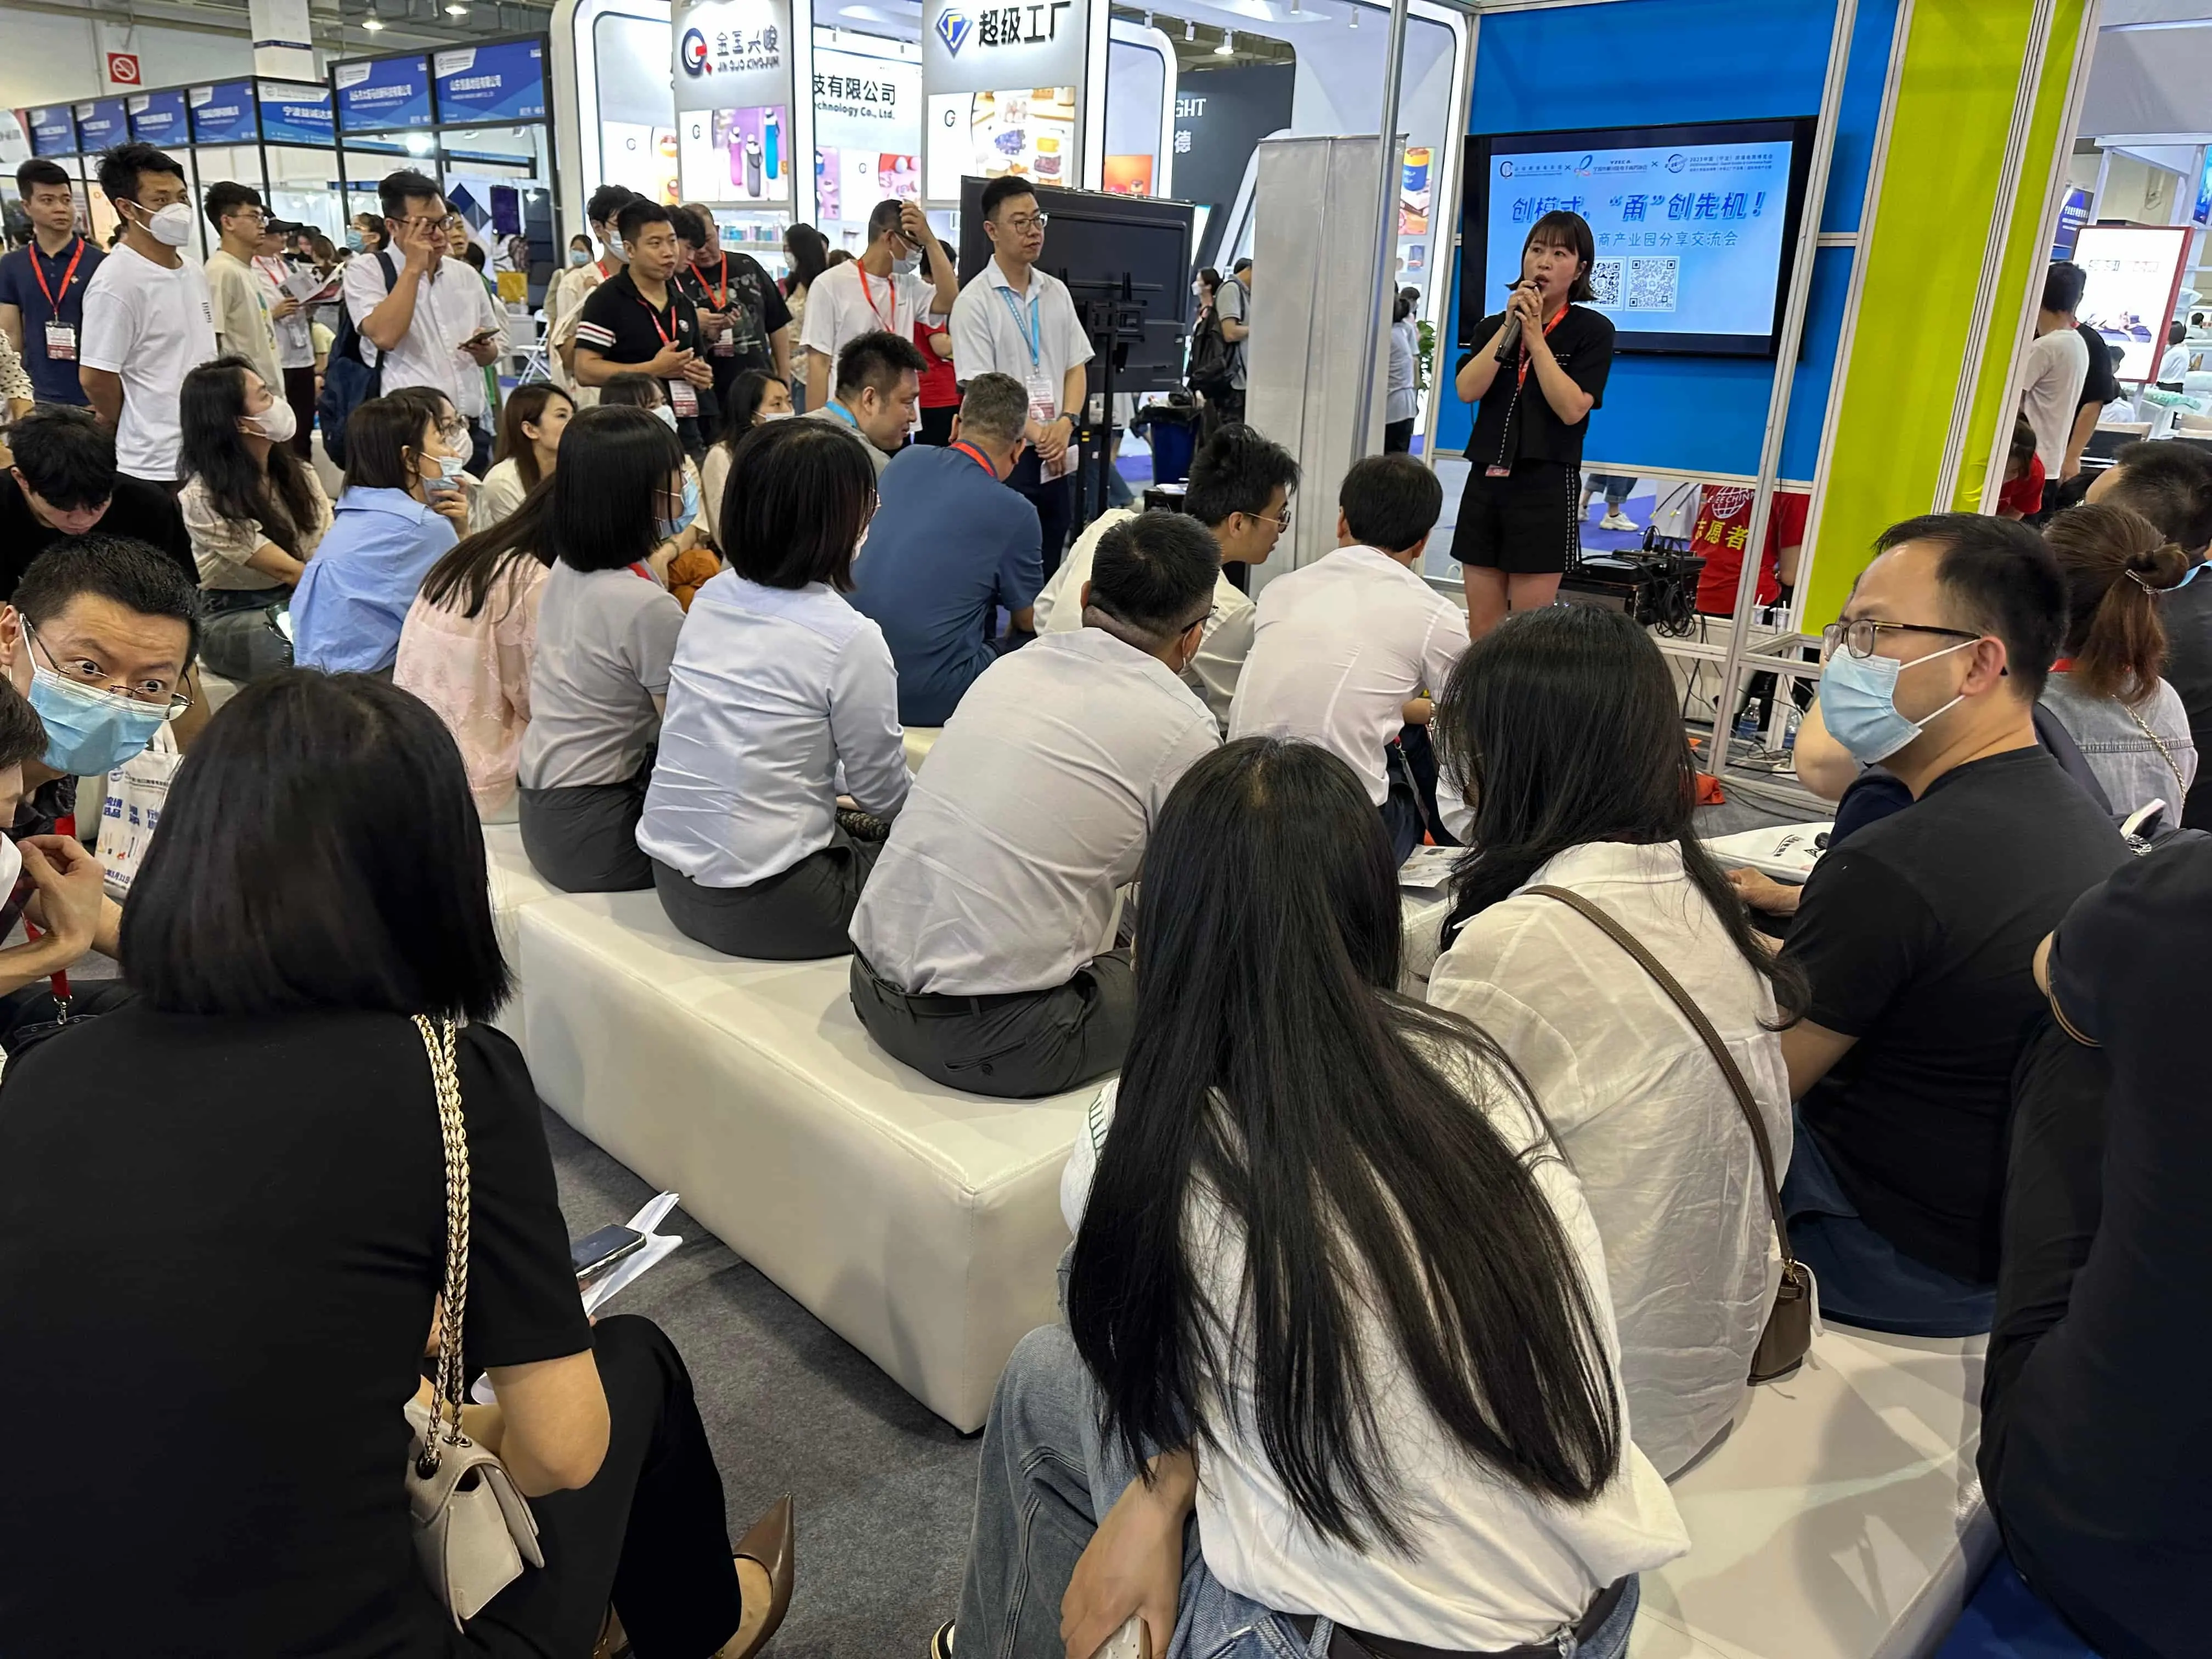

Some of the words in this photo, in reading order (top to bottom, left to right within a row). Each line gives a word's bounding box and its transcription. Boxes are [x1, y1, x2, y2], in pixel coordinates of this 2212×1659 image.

[979, 1, 1071, 47] 超级工厂
[814, 100, 859, 117] chnology
[1598, 231, 1739, 247] 商产业园分享交流会
